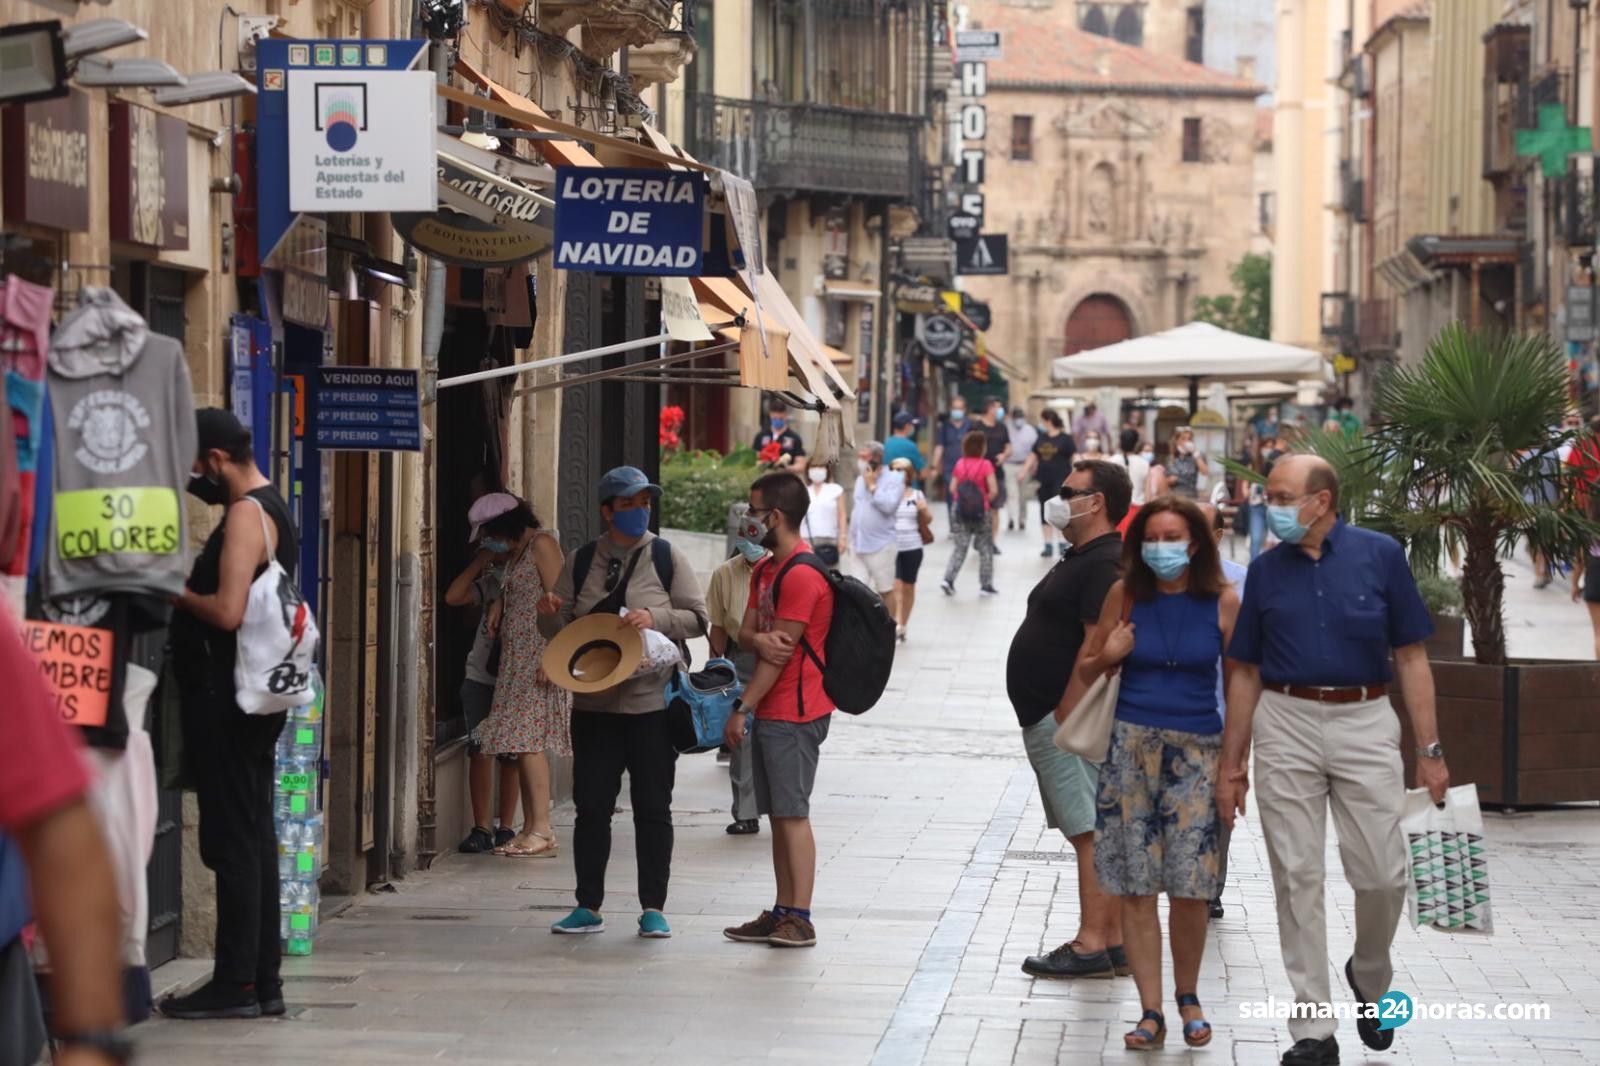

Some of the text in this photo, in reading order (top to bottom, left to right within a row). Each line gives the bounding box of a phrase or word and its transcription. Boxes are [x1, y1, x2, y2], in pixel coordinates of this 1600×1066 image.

[315, 155, 383, 168] Loterías y
[316, 171, 405, 184] Apuestas del
[316, 187, 363, 199] Estado
[562, 175, 695, 204] LOTERÍA
[607, 211, 650, 234] DE
[558, 241, 697, 268] NAVIDAD
[323, 373, 414, 386] VENDIDO AQUÍ
[332, 392, 378, 402] PREMIO
[332, 411, 379, 422] PREMIO
[332, 431, 379, 441] PREMIO
[101, 495, 134, 519] 30
[61, 525, 178, 556] COLORES
